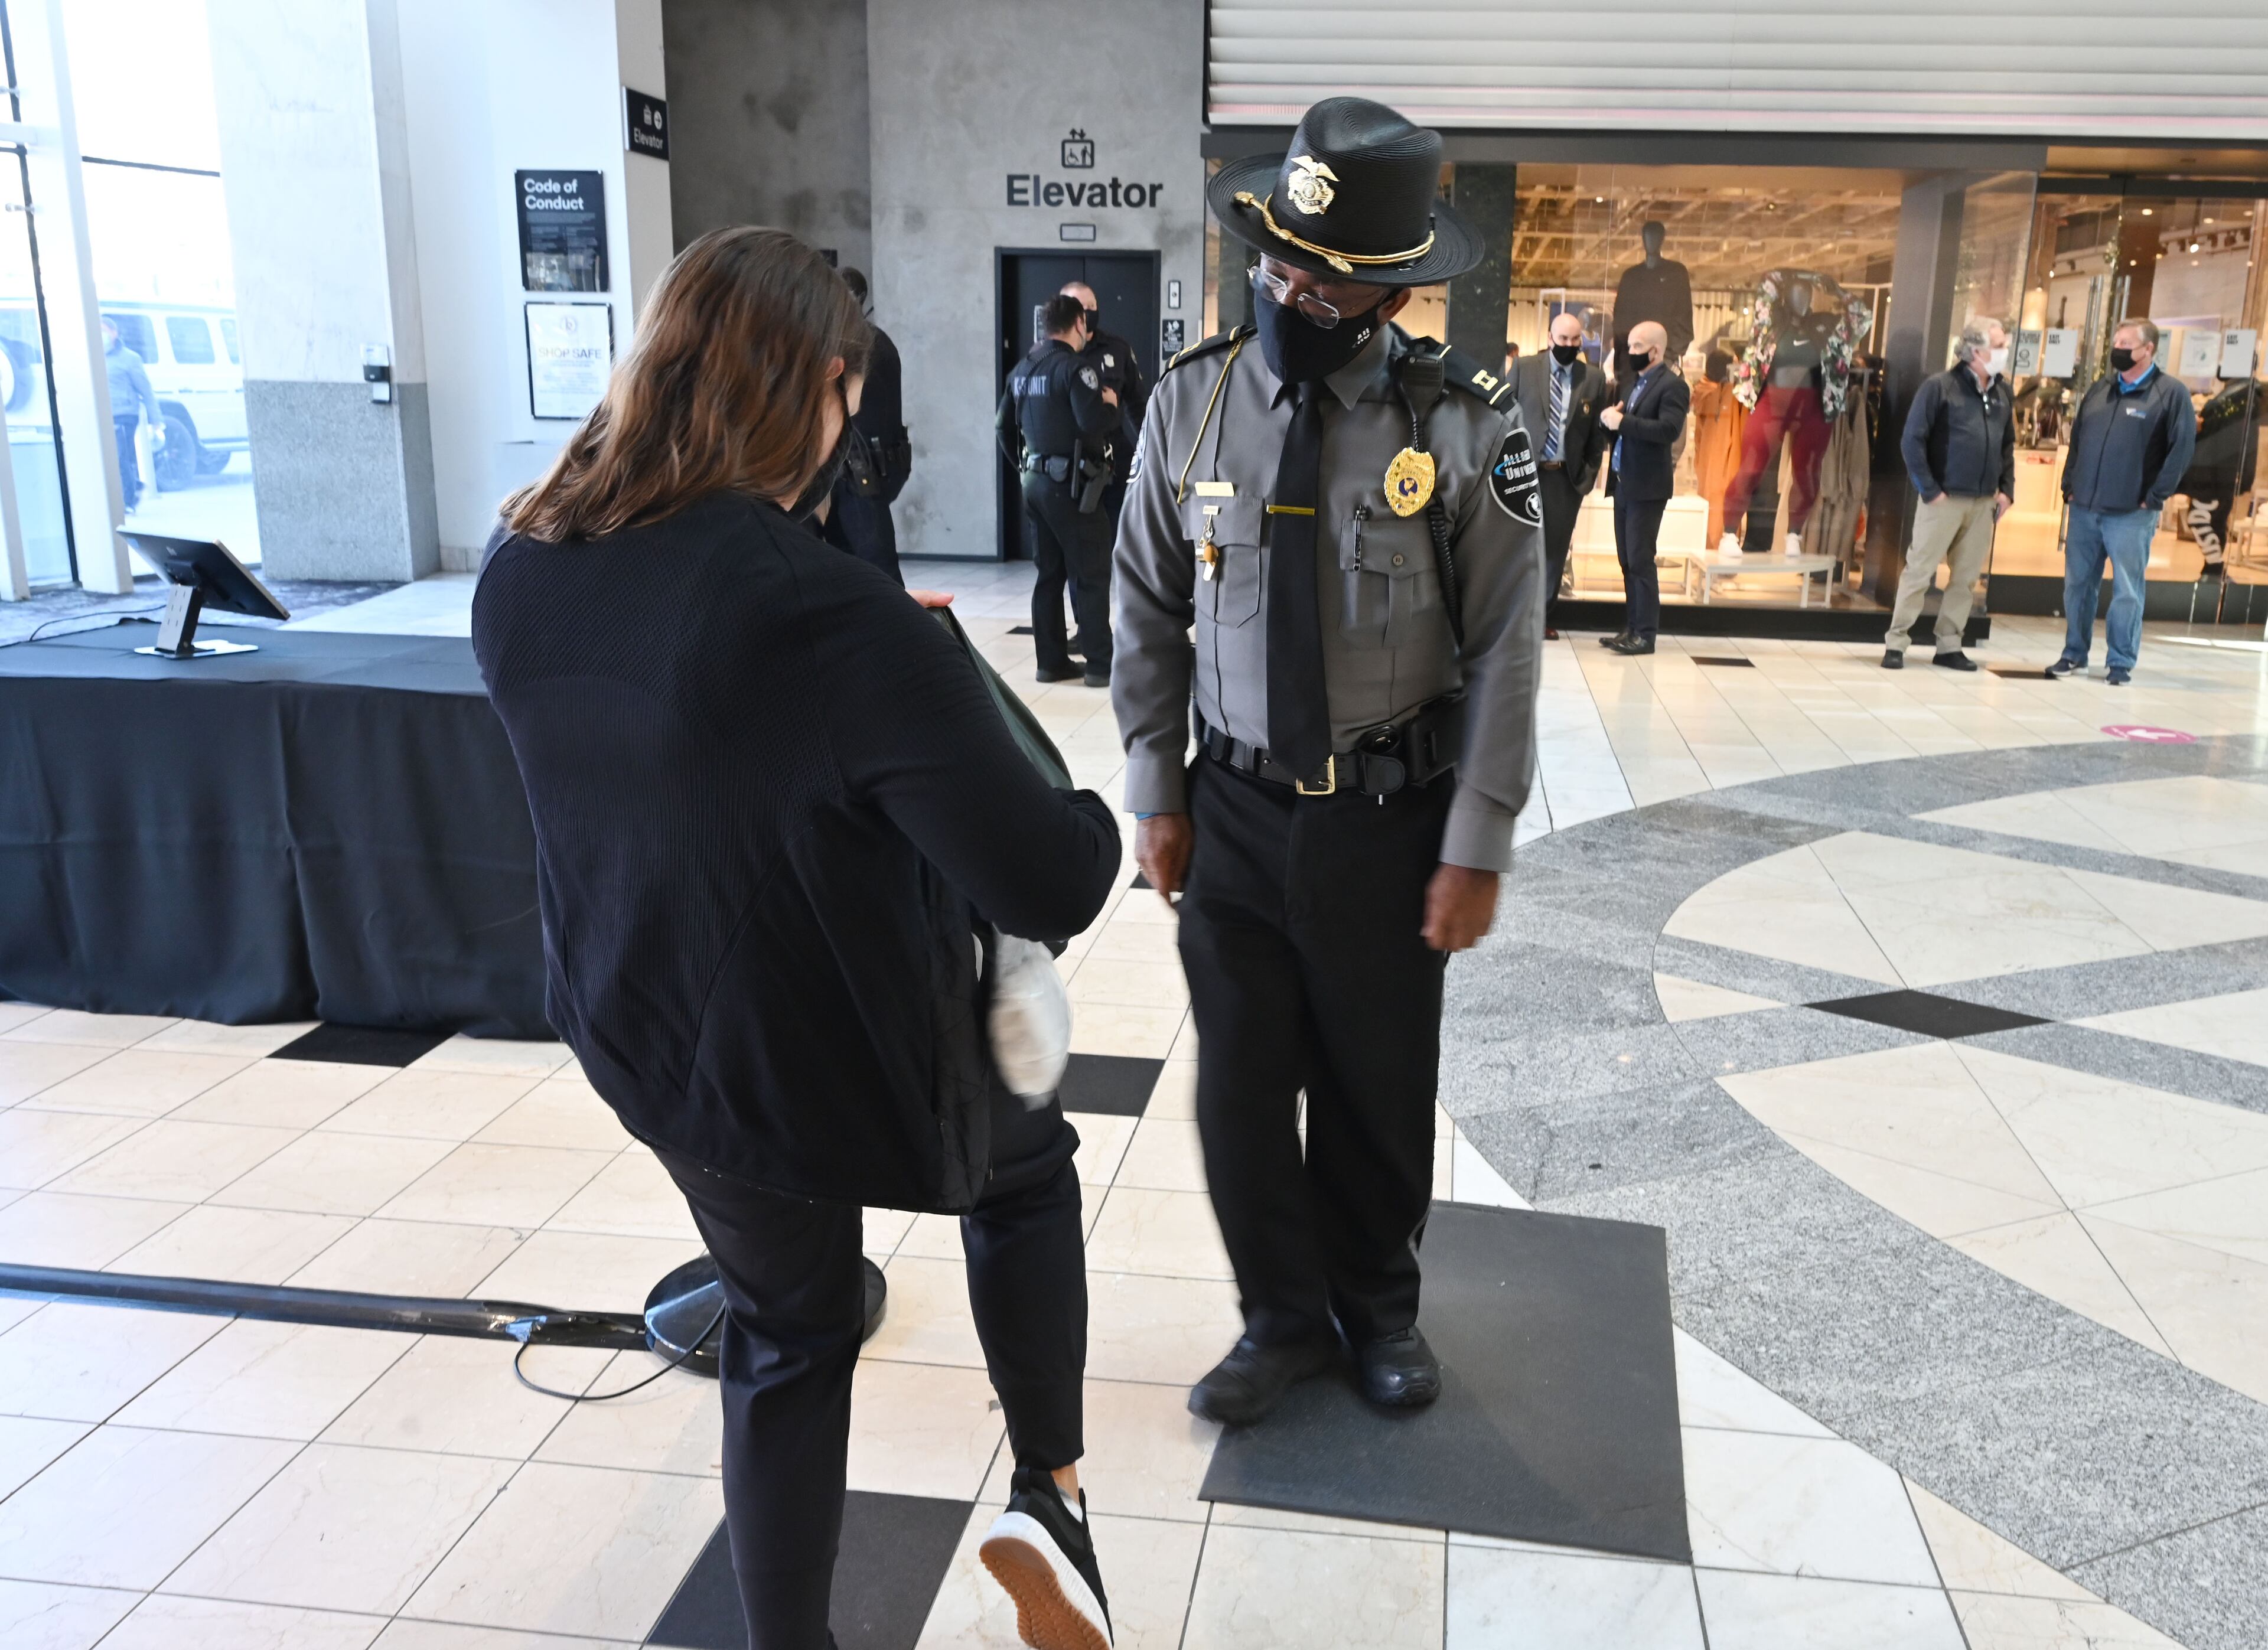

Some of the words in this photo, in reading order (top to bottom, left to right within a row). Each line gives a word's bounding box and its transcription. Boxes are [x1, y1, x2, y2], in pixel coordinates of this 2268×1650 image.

[634, 127, 663, 149] Elevator
[524, 178, 561, 194] Code
[563, 178, 578, 194] of
[1006, 174, 1164, 208] Elevator
[525, 195, 584, 210] Conduct
[538, 347, 570, 358] SHOP
[572, 348, 602, 360] SAFE
[1028, 375, 1047, 396] UNIT
